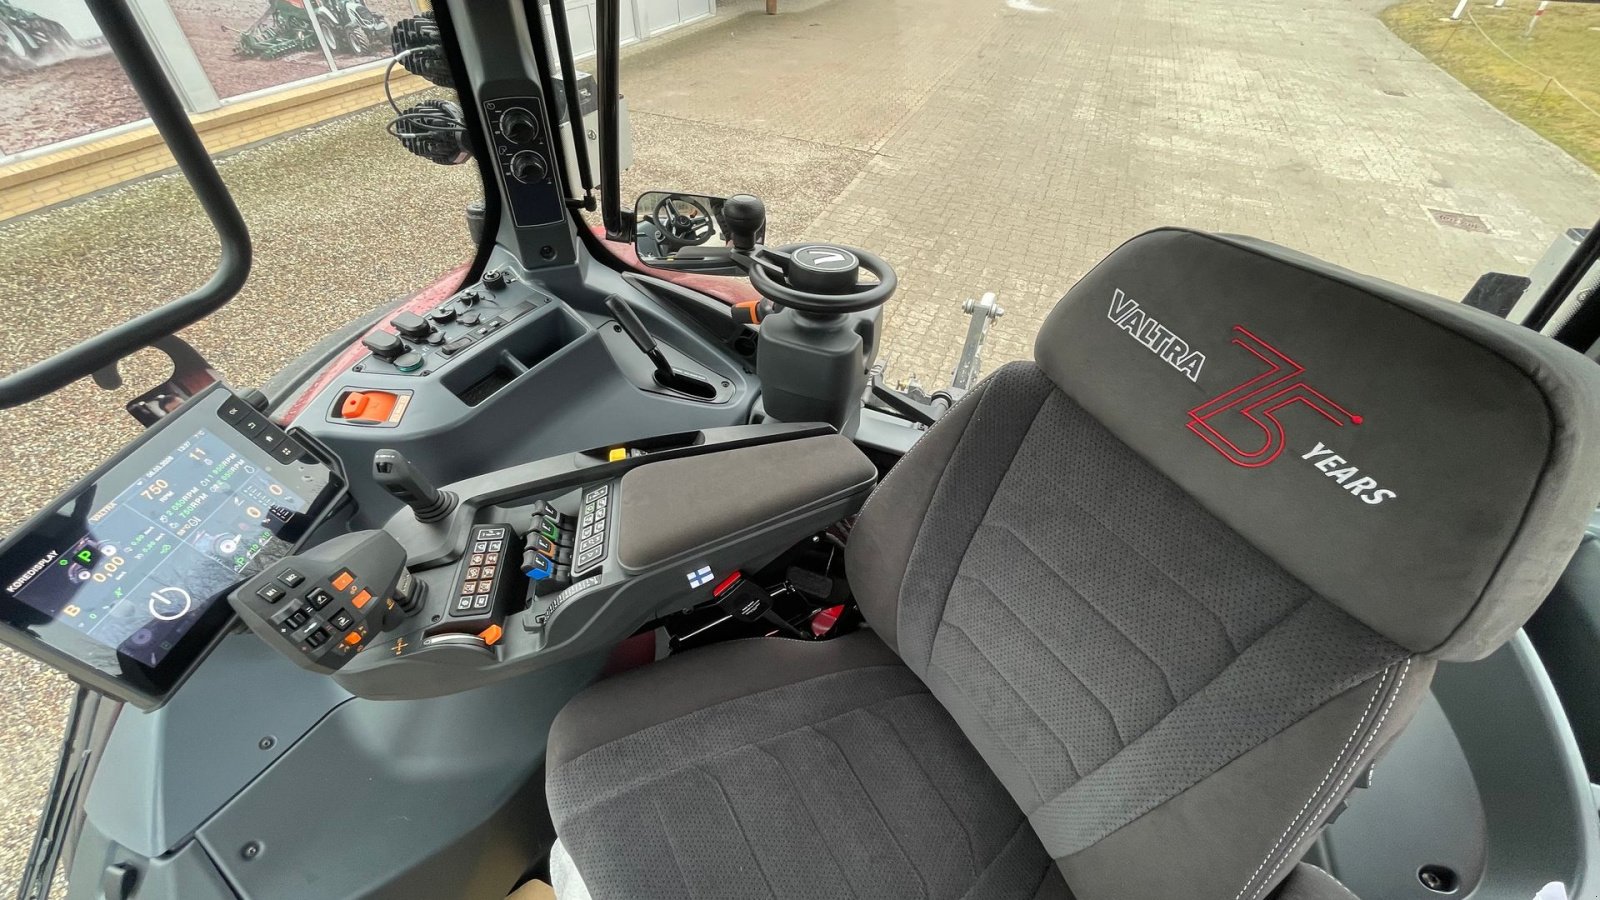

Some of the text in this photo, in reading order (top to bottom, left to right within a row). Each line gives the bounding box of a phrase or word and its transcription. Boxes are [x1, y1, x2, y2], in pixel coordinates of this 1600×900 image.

[1107, 288, 1207, 383] VALTRA
[1185, 325, 1363, 469] 75
[188, 447, 206, 461] 11
[1300, 441, 1397, 506] YEARS
[140, 479, 169, 500] 750
[246, 505, 262, 518] 0
[77, 550, 92, 563] P
[92, 556, 125, 582] 0,00
[285, 573, 298, 582] M2
[265, 588, 278, 597] M1
[63, 604, 81, 618] B
